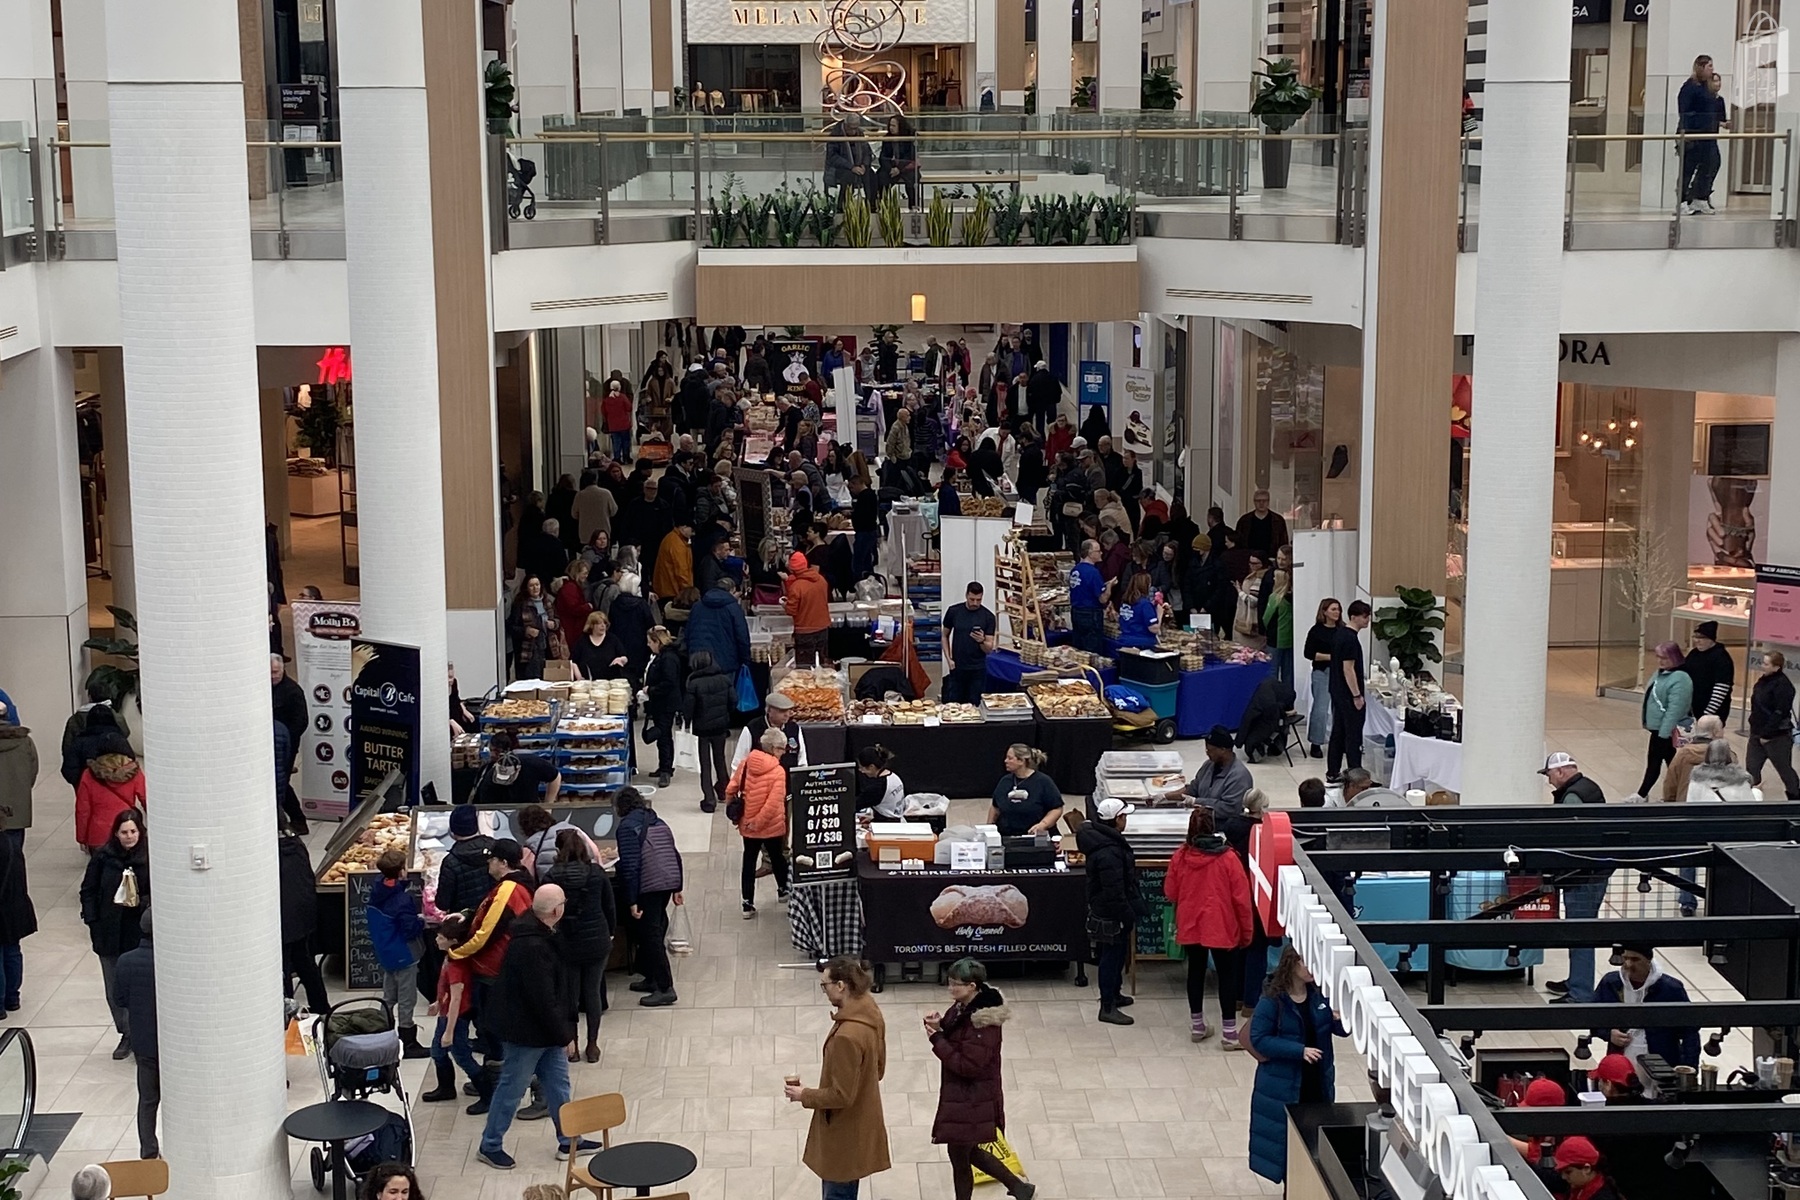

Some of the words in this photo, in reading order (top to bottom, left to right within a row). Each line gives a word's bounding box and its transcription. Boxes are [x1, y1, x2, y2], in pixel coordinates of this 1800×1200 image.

[781, 344, 810, 352] GARLIC
[314, 616, 341, 627] Molly
[354, 684, 380, 698] Capital
[398, 692, 415, 704] Cafe
[364, 741, 404, 760] BUTTER
[805, 779, 843, 787] AUTHENTIC
[807, 805, 815, 816] 4
[822, 803, 838, 816] $14
[807, 819, 814, 830] 6
[821, 817, 840, 830] $20
[805, 832, 816, 844] 12
[955, 926, 974, 939] Holy
[975, 926, 1004, 936] Cannoli
[1277, 865, 1356, 1011] DANISH
[894, 945, 942, 954] TORONTO'S
[944, 945, 966, 953] BEST
[968, 945, 996, 953] FRESH
[998, 945, 1027, 953] FILLED
[1029, 944, 1067, 952] CANNOLI
[1338, 965, 1441, 1147] COFFEE
